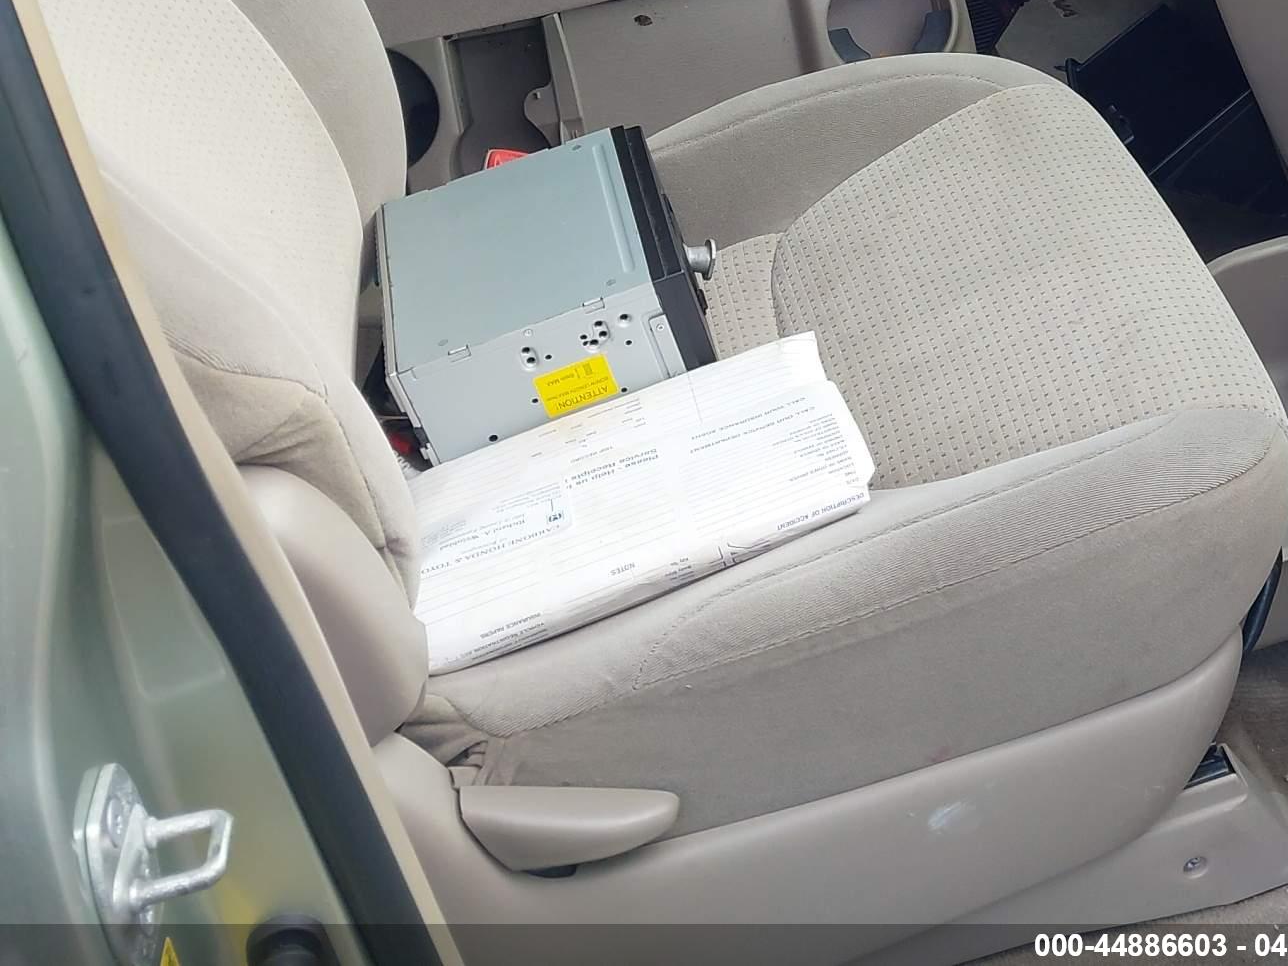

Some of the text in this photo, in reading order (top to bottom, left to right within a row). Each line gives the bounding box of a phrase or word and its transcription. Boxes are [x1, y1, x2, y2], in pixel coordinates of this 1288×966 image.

[556, 386, 608, 411] ATTENTION!
[619, 449, 657, 464] Service
[777, 492, 865, 531] DESCRIPTION OF ACCIDENT
[465, 543, 505, 561] HONDA
[609, 562, 636, 576] NOTES
[480, 613, 541, 639] INSURANCE PAPERS
